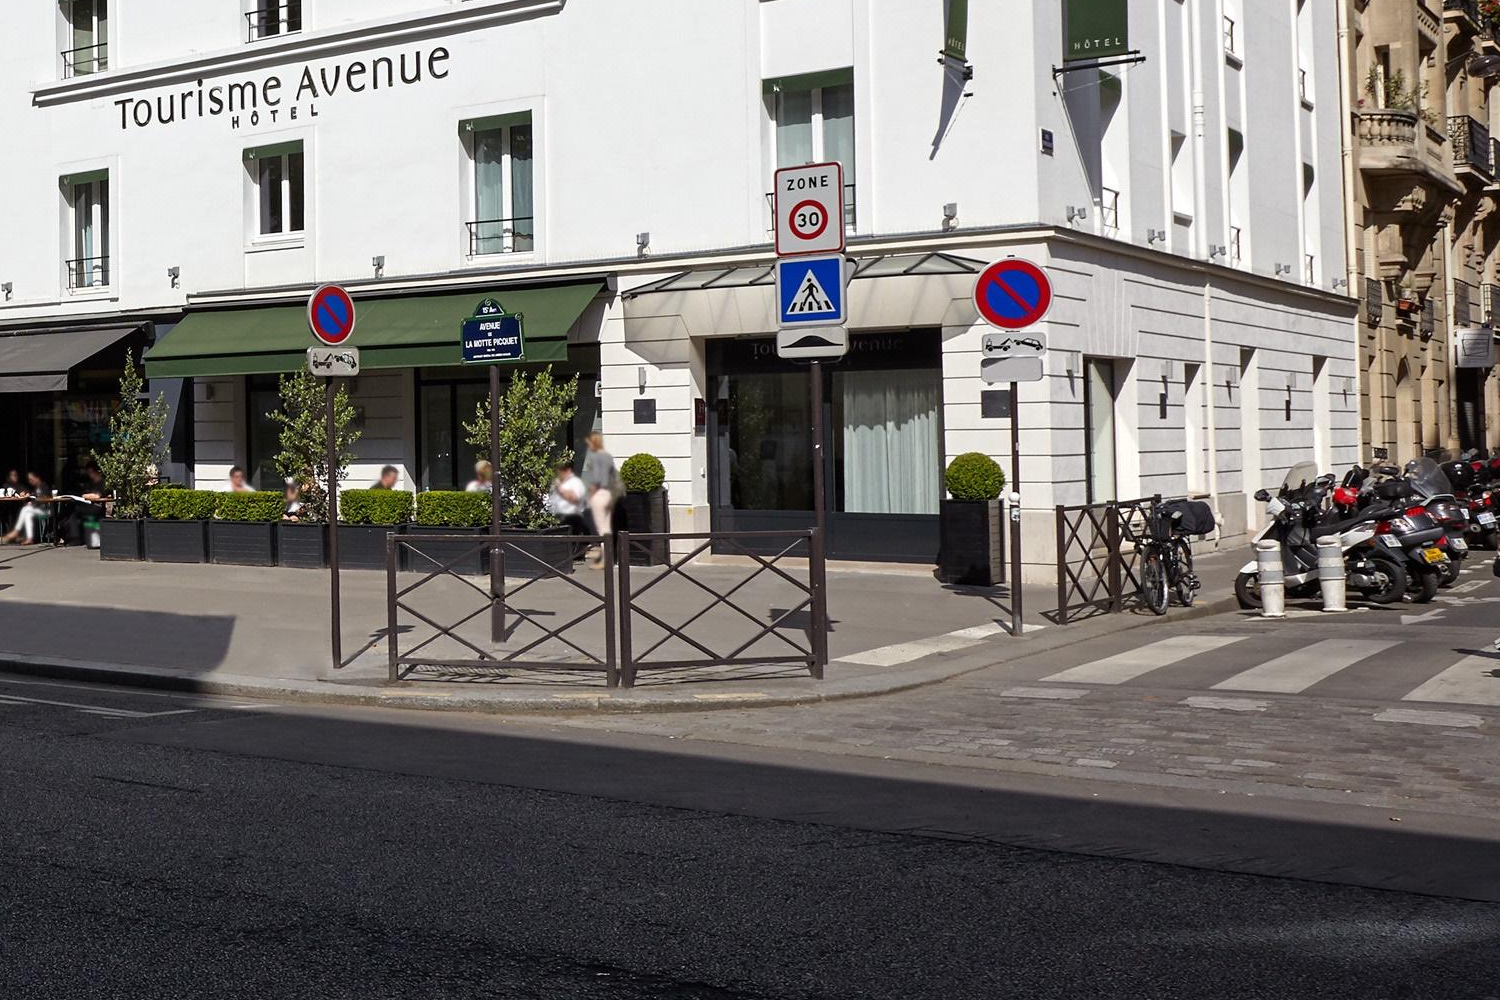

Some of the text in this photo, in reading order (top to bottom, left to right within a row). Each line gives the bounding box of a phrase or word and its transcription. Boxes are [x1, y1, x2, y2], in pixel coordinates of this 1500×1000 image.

[1074, 37, 1120, 50] HÔTEL
[114, 46, 450, 130] Tourisme Avenue
[231, 103, 319, 129] HÔTEL
[787, 175, 828, 191] ZONE
[798, 212, 819, 228] 30
[479, 322, 501, 331] AVENUE
[465, 340, 473, 348] LA
[474, 339, 492, 348] MOTTE
